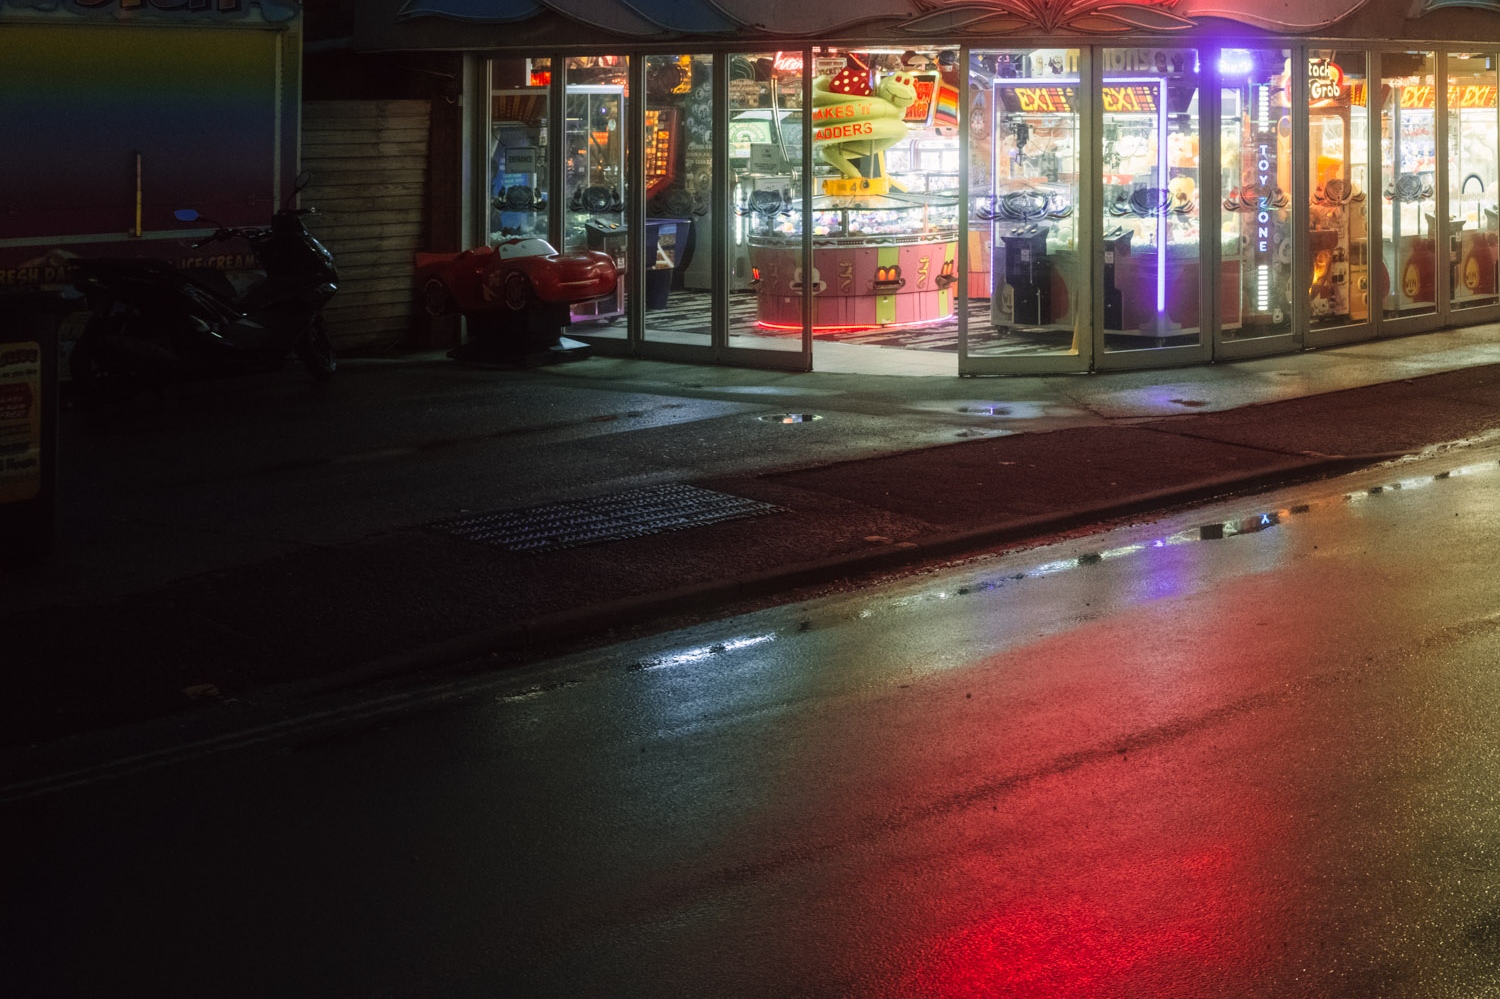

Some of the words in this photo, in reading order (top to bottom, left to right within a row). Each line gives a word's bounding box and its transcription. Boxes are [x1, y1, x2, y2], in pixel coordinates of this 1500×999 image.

[1308, 61, 1331, 77] tack
[1311, 82, 1341, 98] Grab
[812, 122, 873, 141] ADDERS
[1259, 144, 1269, 187] TOY
[1257, 196, 1269, 253] ZONE
